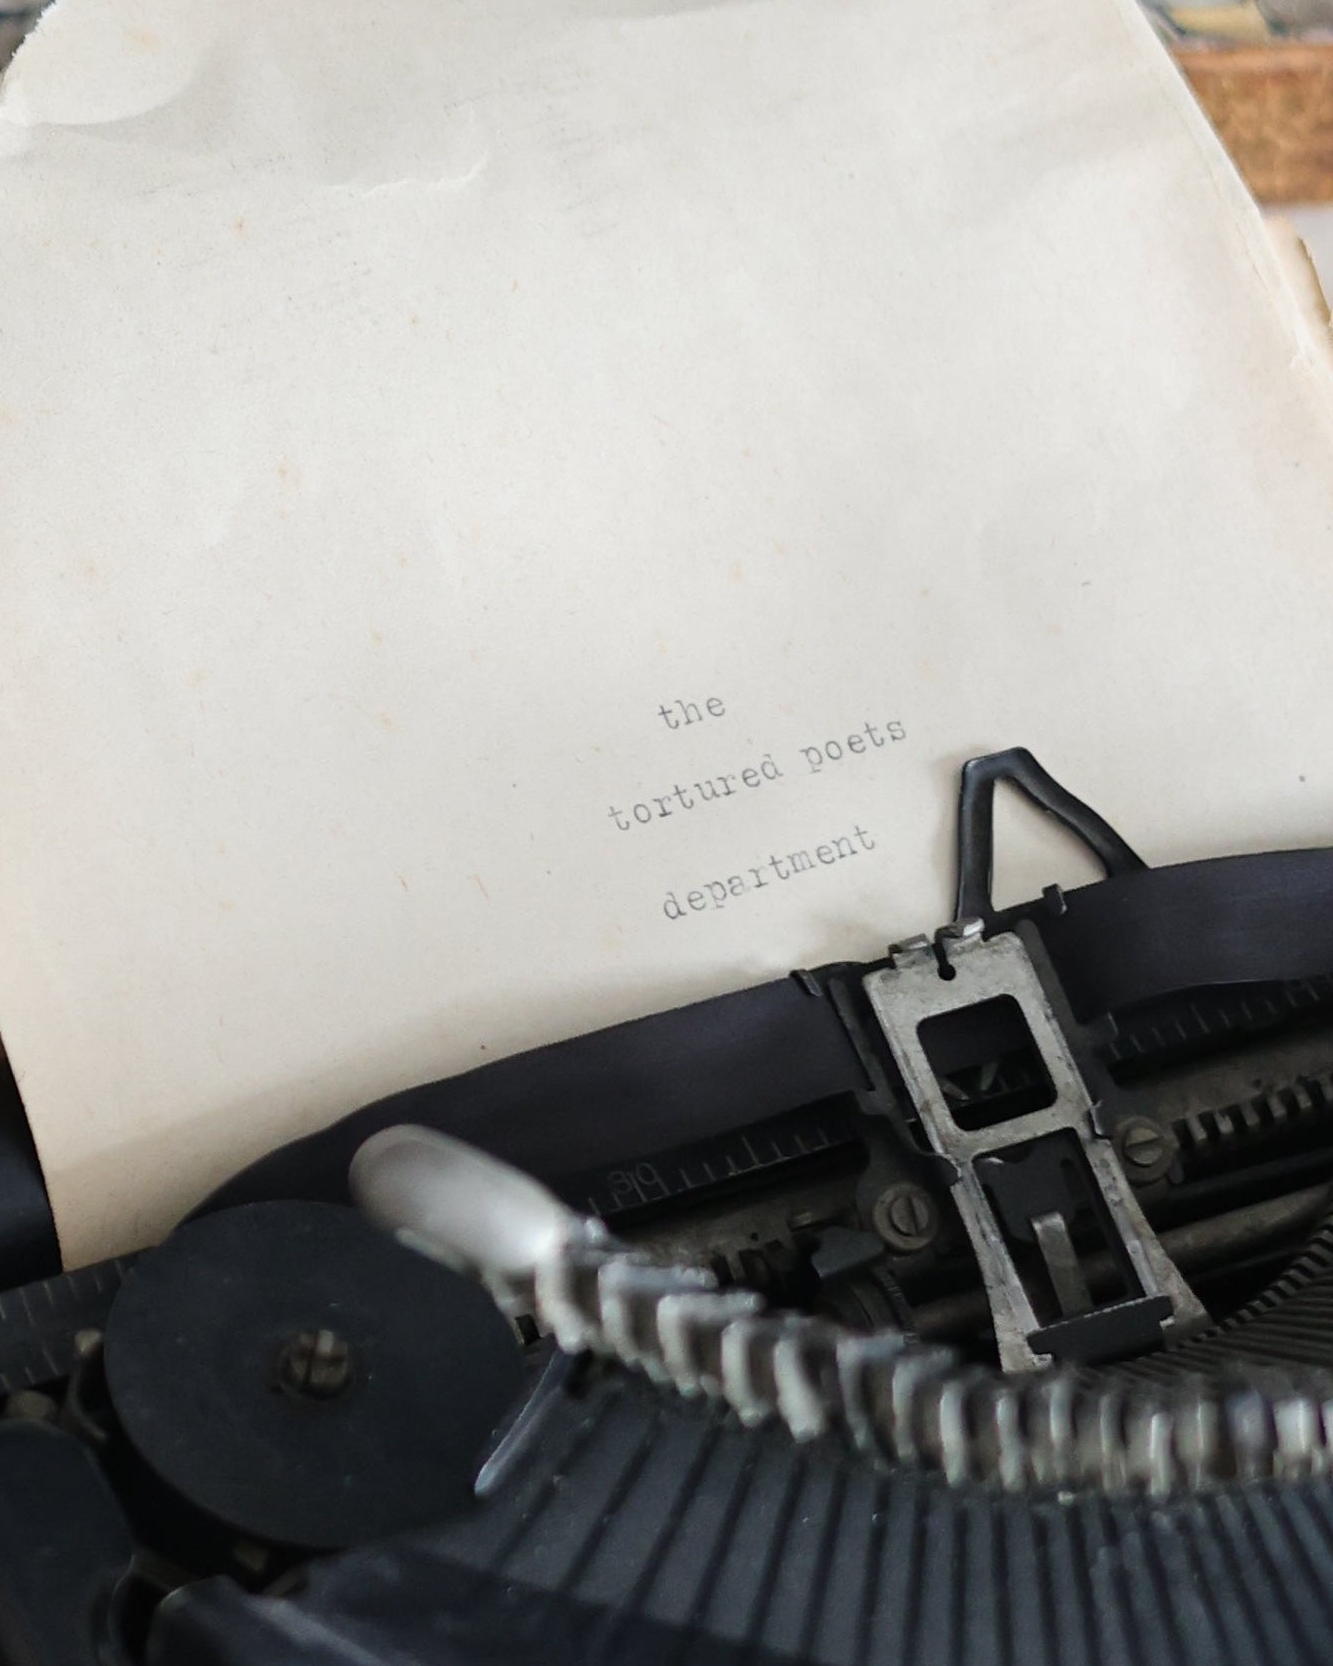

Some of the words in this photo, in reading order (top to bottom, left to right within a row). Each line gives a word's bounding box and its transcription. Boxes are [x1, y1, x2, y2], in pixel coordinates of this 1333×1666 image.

[657, 696, 726, 730] the
[607, 754, 783, 831] tortured
[800, 719, 907, 773] poets
[662, 824, 876, 920] department
